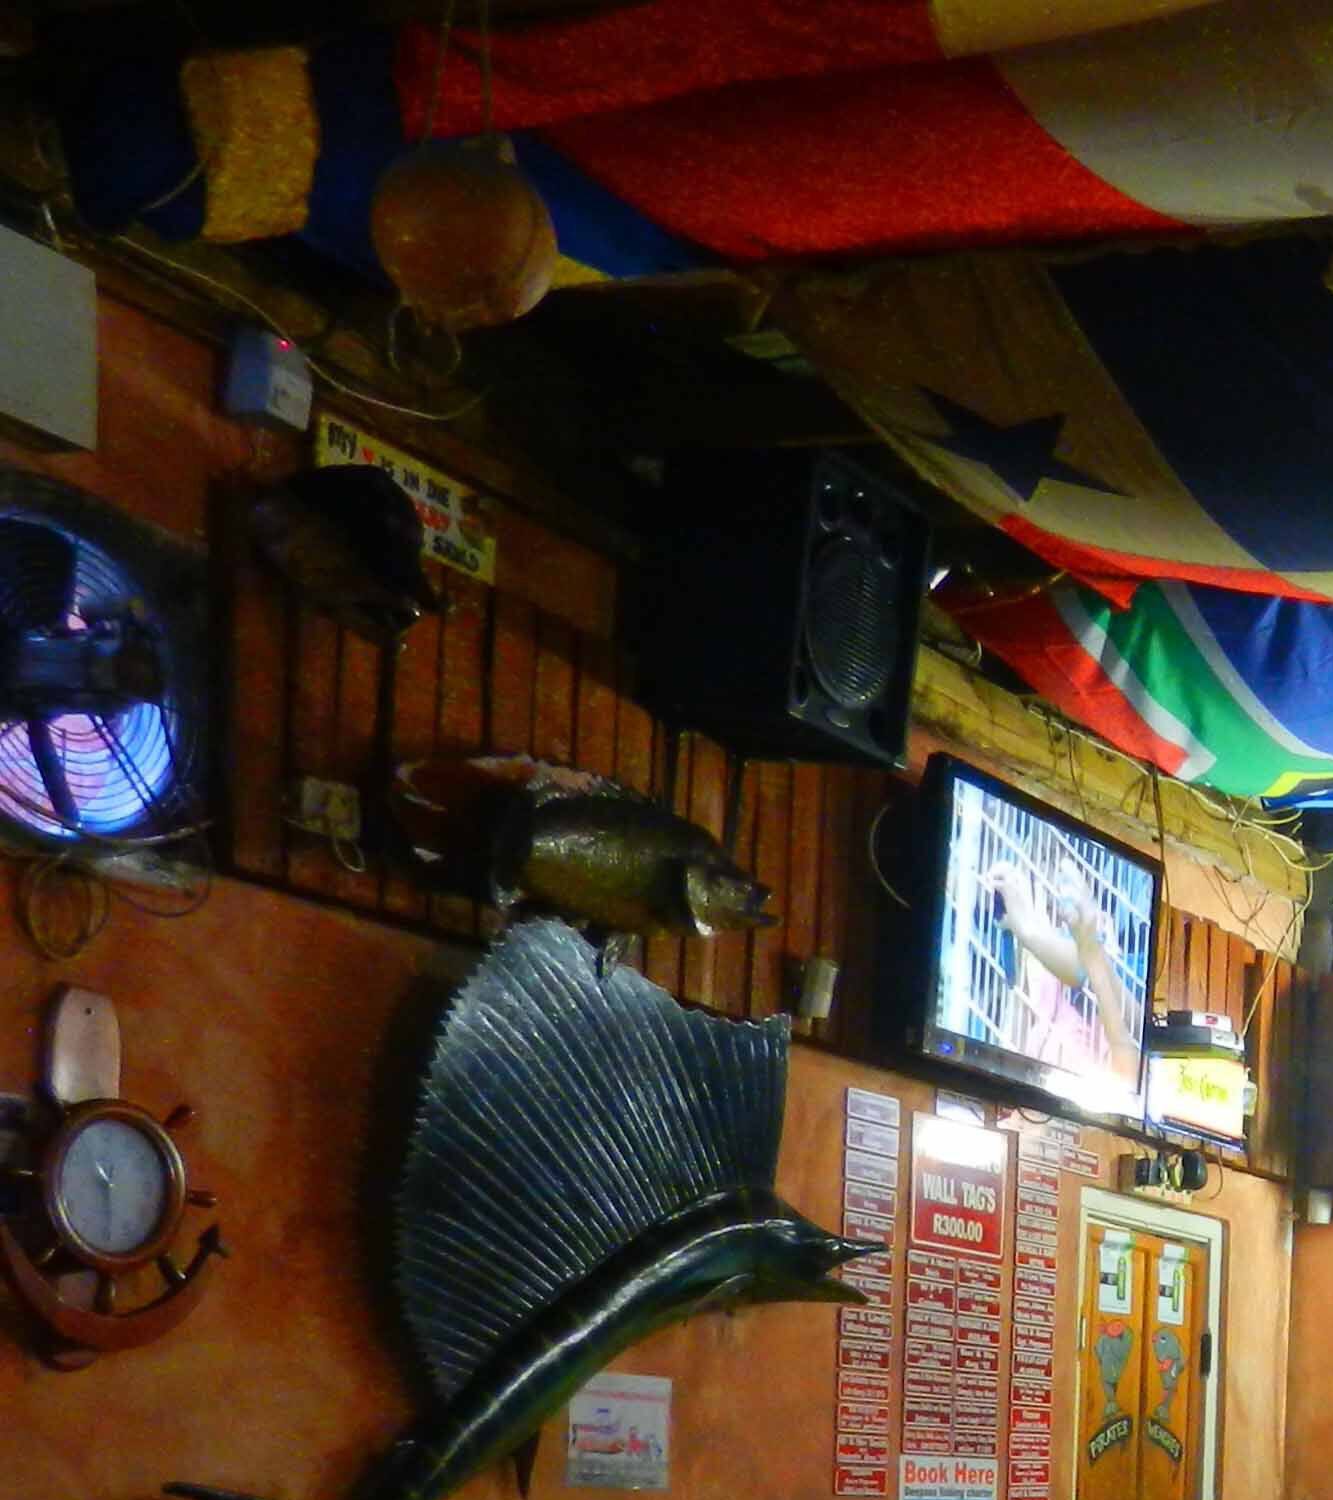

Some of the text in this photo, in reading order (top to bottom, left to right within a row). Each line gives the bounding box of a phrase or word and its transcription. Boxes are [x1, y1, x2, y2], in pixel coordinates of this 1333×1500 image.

[922, 1172, 957, 1205] WALL
[932, 1212, 983, 1244] R300.00
[904, 1460, 993, 1485] Book Here
